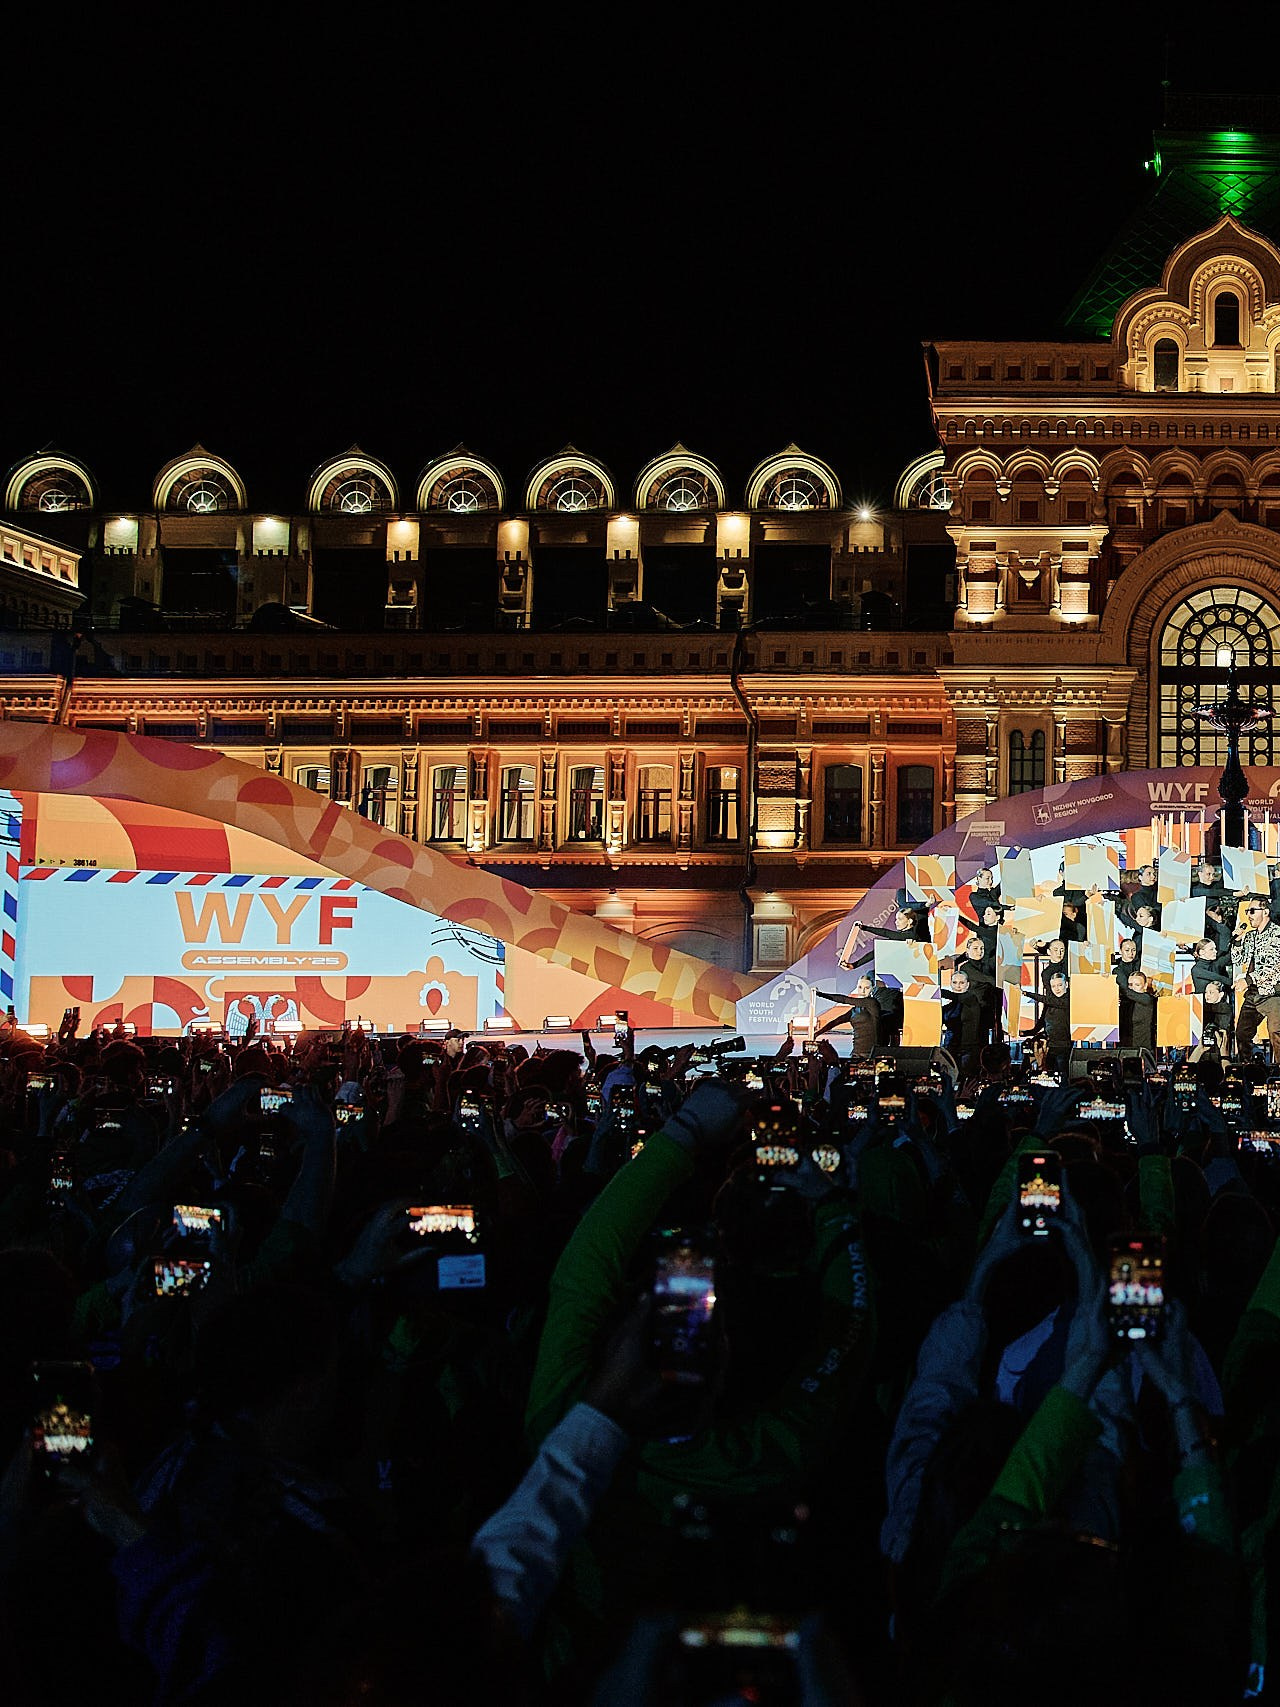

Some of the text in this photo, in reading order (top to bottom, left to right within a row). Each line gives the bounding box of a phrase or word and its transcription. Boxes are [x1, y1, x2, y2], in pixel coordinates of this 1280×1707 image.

[1147, 782, 1210, 802] WYF
[1052, 793, 1114, 812] NIZHNY NOVGOROD
[1054, 808, 1078, 818] REGION
[175, 891, 358, 945] WYF
[192, 956, 340, 966] ASSEMBLY'25
